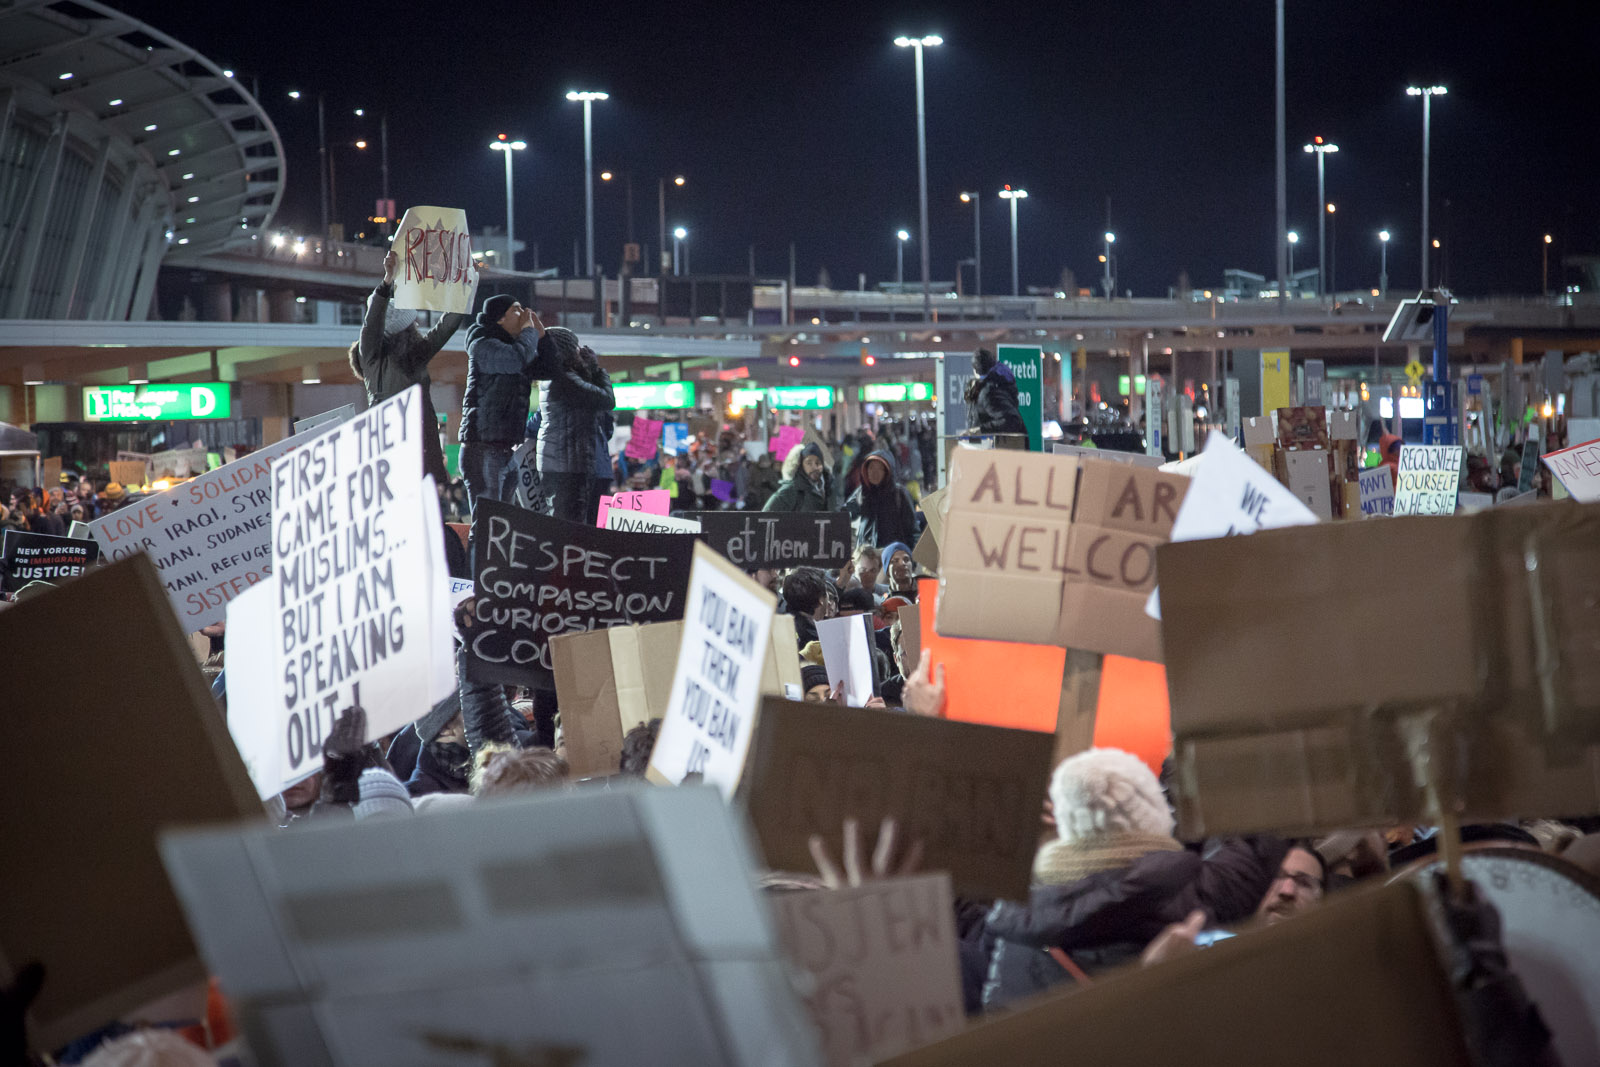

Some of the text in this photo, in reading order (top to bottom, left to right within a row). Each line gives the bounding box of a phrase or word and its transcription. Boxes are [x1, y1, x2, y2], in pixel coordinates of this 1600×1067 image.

[190, 386, 216, 416] D
[274, 391, 413, 508] FIRST THEY
[1400, 447, 1462, 472] RECOGNIZE
[631, 495, 643, 511] IS
[970, 462, 1069, 510] ALL
[1395, 497, 1407, 512] IN
[1409, 492, 1428, 515] HE
[1431, 492, 1455, 515] SHE
[1399, 473, 1457, 493] YOURSELF
[101, 503, 164, 543] LOVE
[164, 507, 227, 541] IRAQI,
[276, 459, 394, 559] CAME FOR
[17, 546, 87, 556] NEW YORKERS
[30, 556, 87, 565] IMMIGRANT
[211, 541, 272, 575] REFUGE
[279, 509, 408, 609] MUSLIMS...
[487, 516, 668, 580] RESPECT
[758, 518, 809, 562] Them
[813, 519, 845, 559] In
[972, 524, 1151, 586] WELCO
[12, 565, 86, 579] JUSTICE!
[480, 567, 674, 615] COMPASSION
[283, 559, 396, 656] BUT I AM
[476, 597, 651, 633] CURIOSIT
[700, 583, 759, 661] YOU BAN
[284, 605, 405, 710] SPEAKING
[681, 677, 742, 754] YOU BAN
